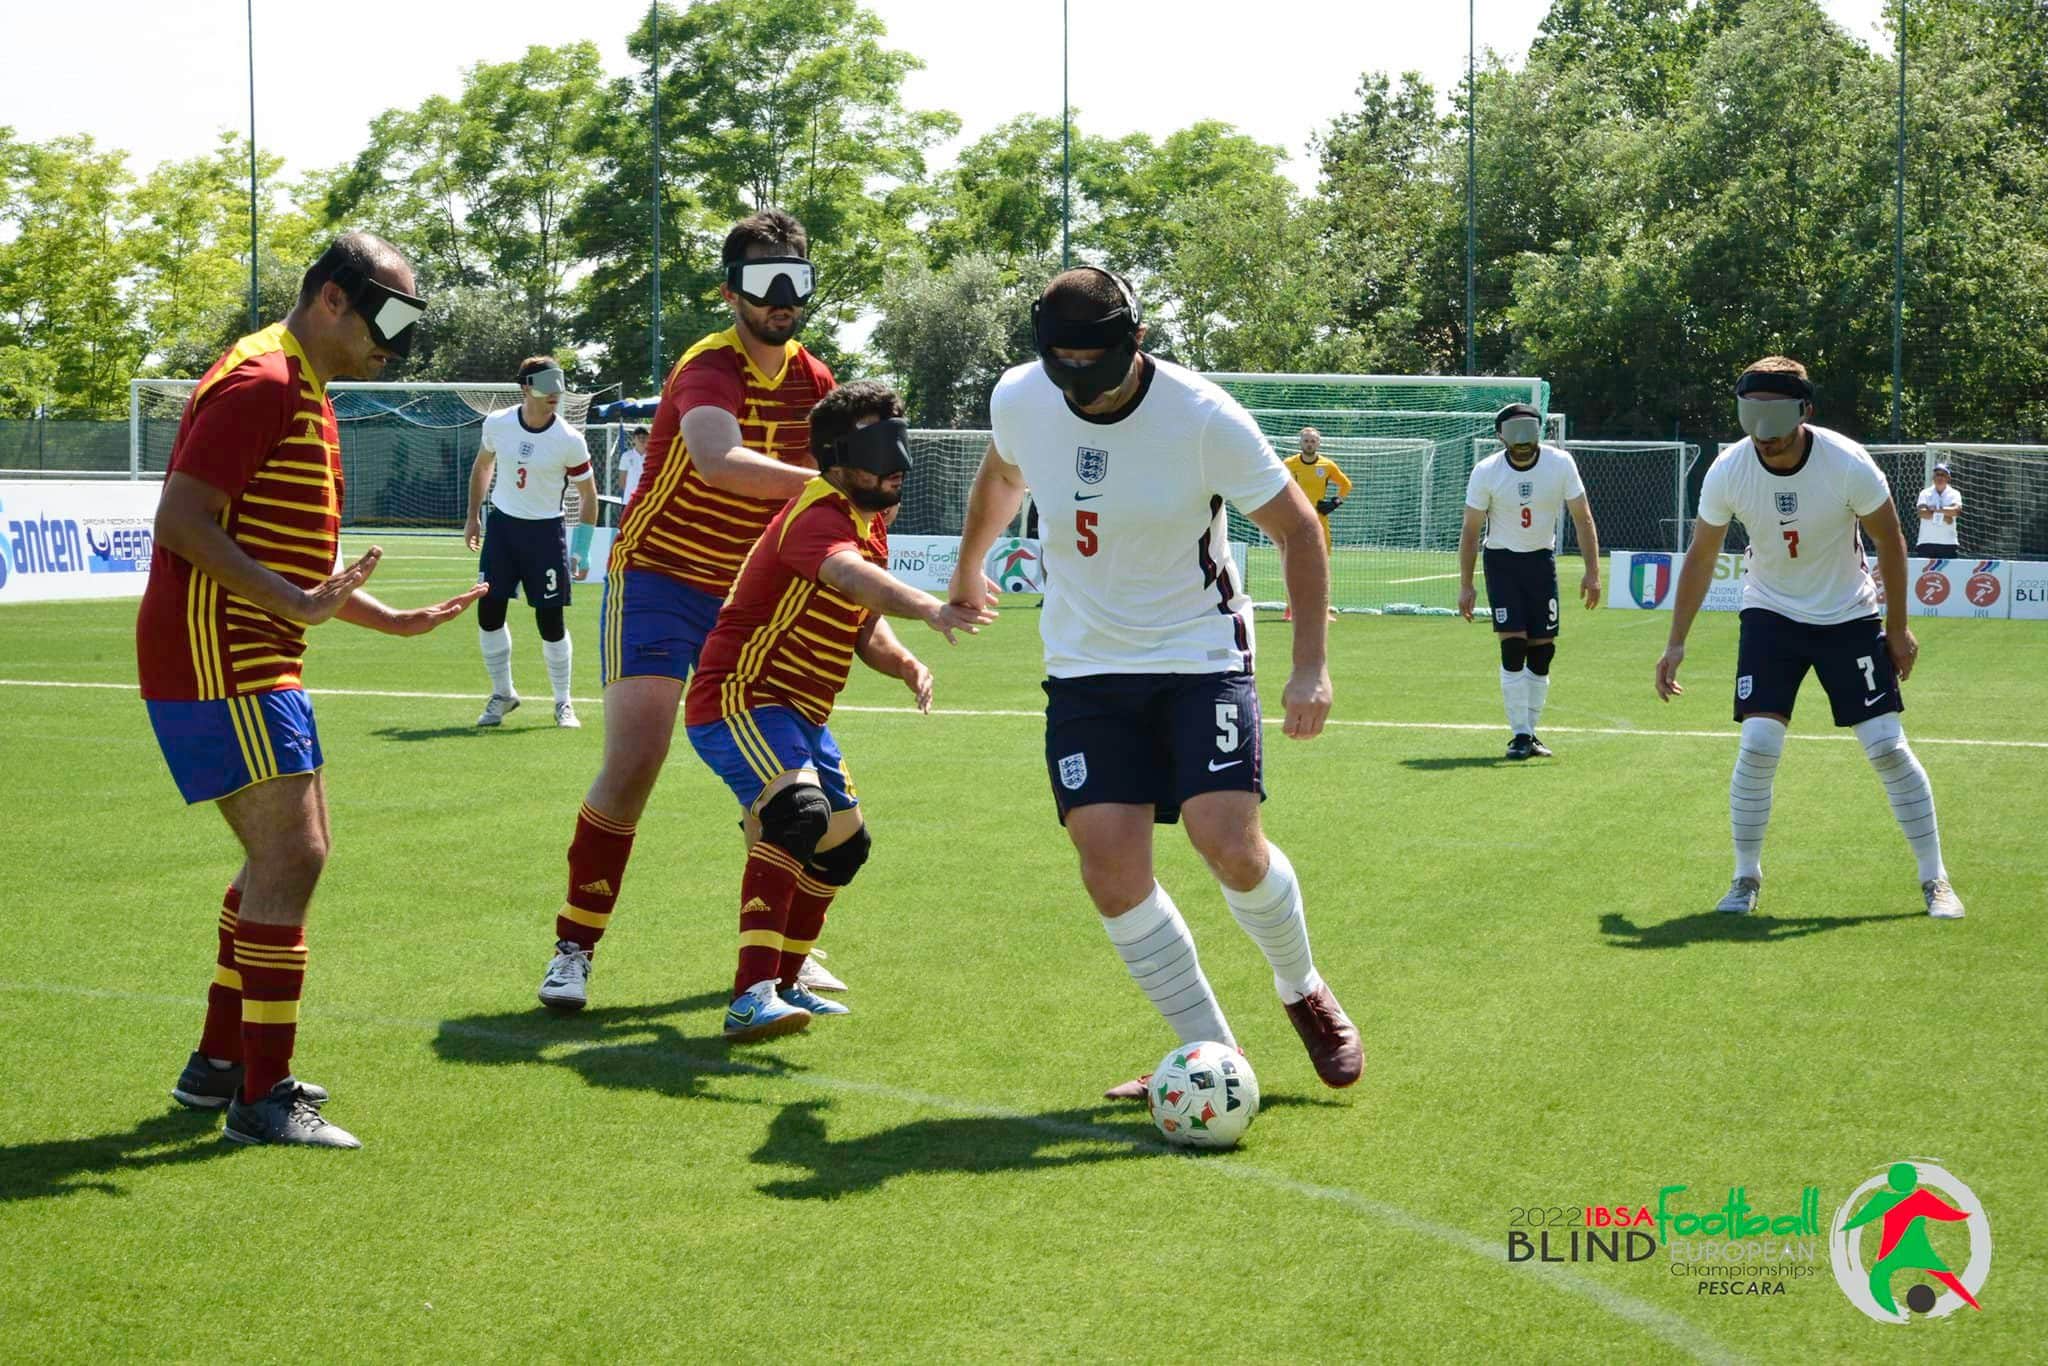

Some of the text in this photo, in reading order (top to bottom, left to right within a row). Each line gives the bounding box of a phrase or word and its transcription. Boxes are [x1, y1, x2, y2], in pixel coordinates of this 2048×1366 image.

[517, 468, 527, 489] 3
[1521, 508, 1531, 528] 9
[0, 507, 84, 580] anten
[1075, 509, 1098, 557] 5
[1783, 530, 1799, 558] 7
[892, 559, 925, 571] IND
[546, 568, 557, 591] 3
[2016, 589, 2048, 601] BLI
[1549, 598, 1557, 621] 9
[1856, 655, 1877, 692] 7
[1215, 703, 1239, 752] 5
